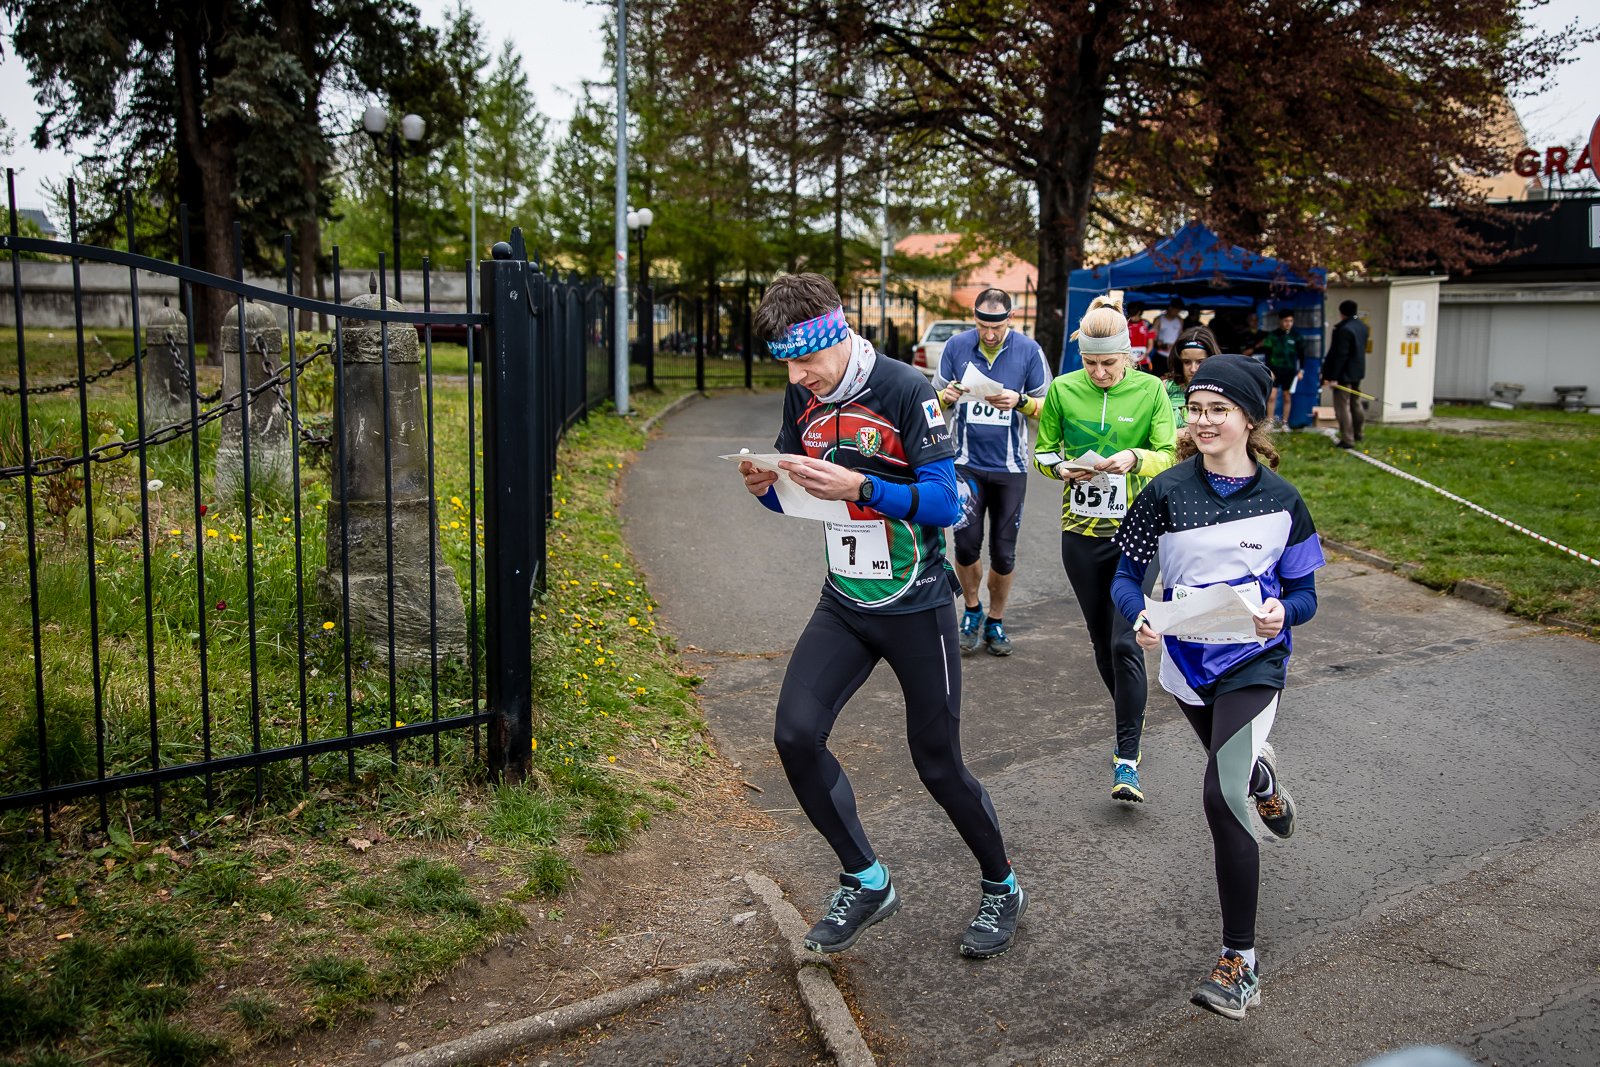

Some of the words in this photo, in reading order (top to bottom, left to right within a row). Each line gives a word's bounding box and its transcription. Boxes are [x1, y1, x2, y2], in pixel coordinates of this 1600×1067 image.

[1074, 485, 1118, 508] 657
[841, 535, 857, 566] 7
[872, 560, 889, 570] M21
